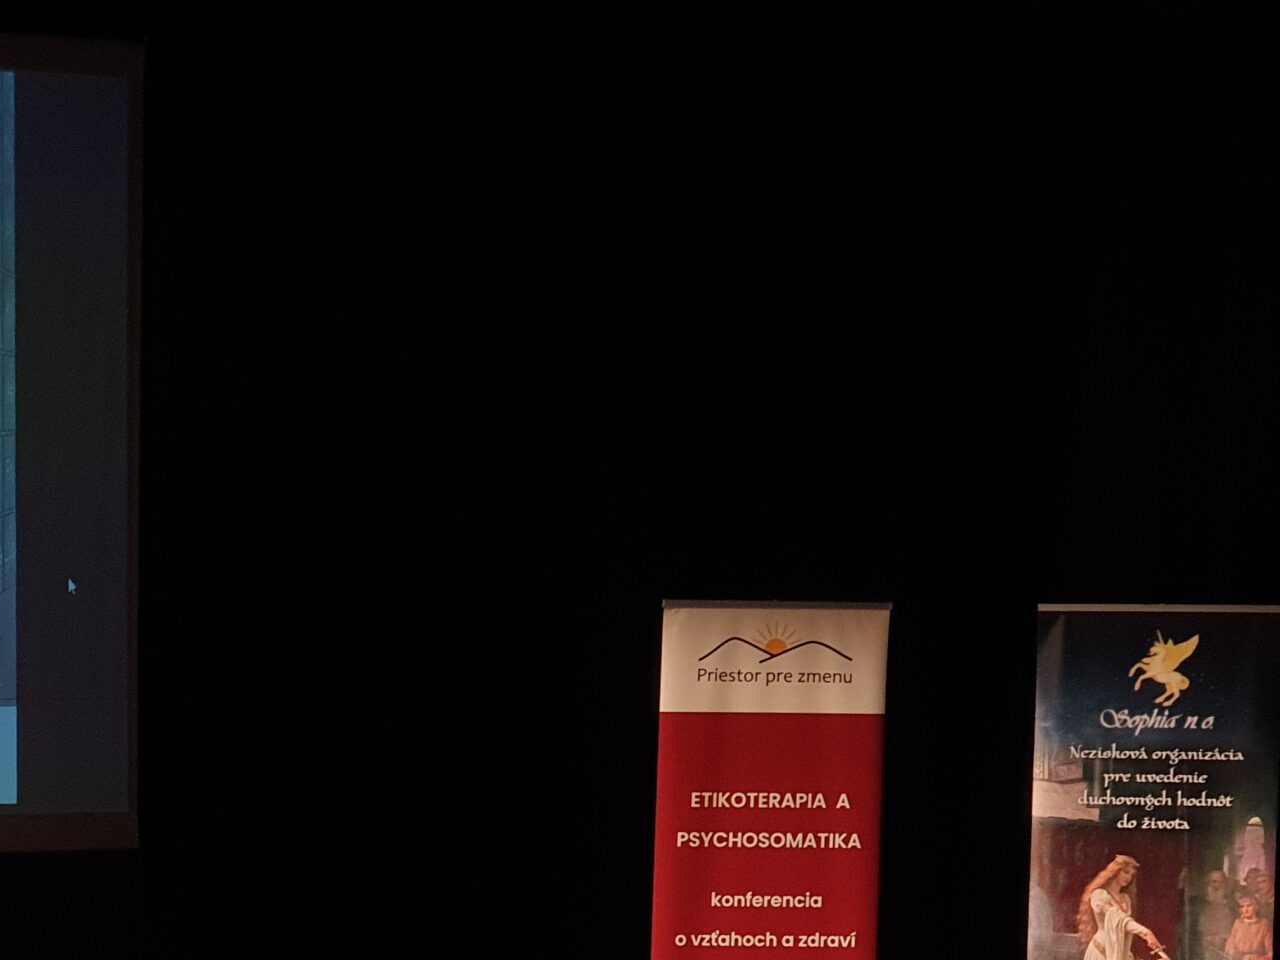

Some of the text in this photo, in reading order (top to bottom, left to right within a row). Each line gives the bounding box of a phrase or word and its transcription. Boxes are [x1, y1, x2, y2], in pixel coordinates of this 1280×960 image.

[697, 667, 853, 687] Priestor pre zmenu
[1100, 708, 1183, 736] Sophia
[1070, 743, 1245, 764] Nezisková organizácia
[1103, 767, 1209, 787] pre uvedenie
[690, 791, 851, 809] ETIKOTERAPIA A
[1078, 789, 1235, 810] duchovných hodnôt
[1117, 812, 1191, 830] do života
[676, 831, 862, 849] PSYCHOSOMATIKA
[710, 891, 823, 908] konferencia
[674, 929, 857, 948] o vzťahoch a zdraví
